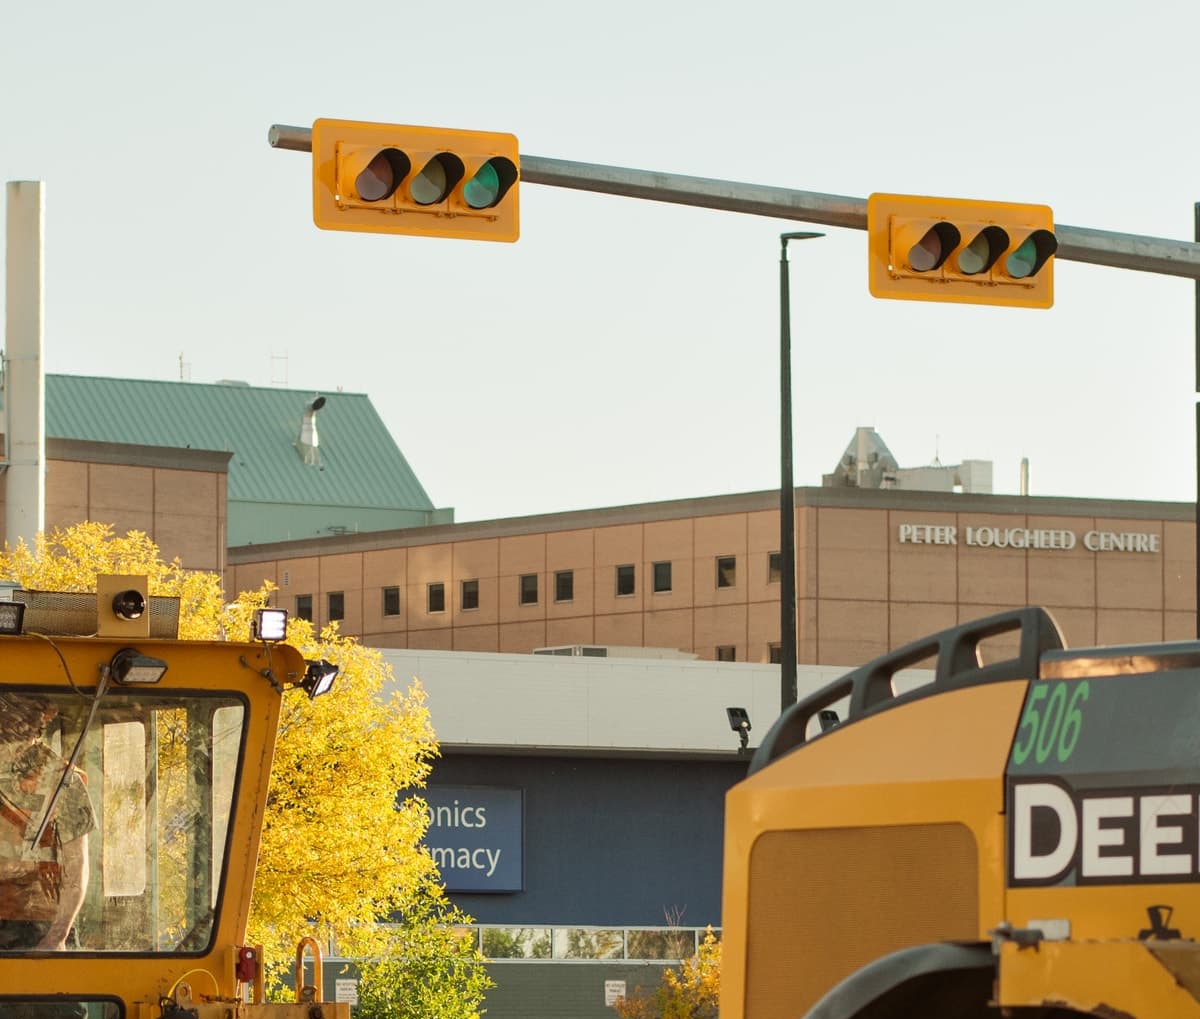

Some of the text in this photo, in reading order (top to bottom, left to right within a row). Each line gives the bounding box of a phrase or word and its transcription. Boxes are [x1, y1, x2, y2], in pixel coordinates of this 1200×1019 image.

[898, 523, 1160, 553] PETER LOUGHEED CENTRE
[1013, 680, 1090, 765] 506
[1014, 783, 1200, 880] DEE
[427, 847, 501, 877] macy
